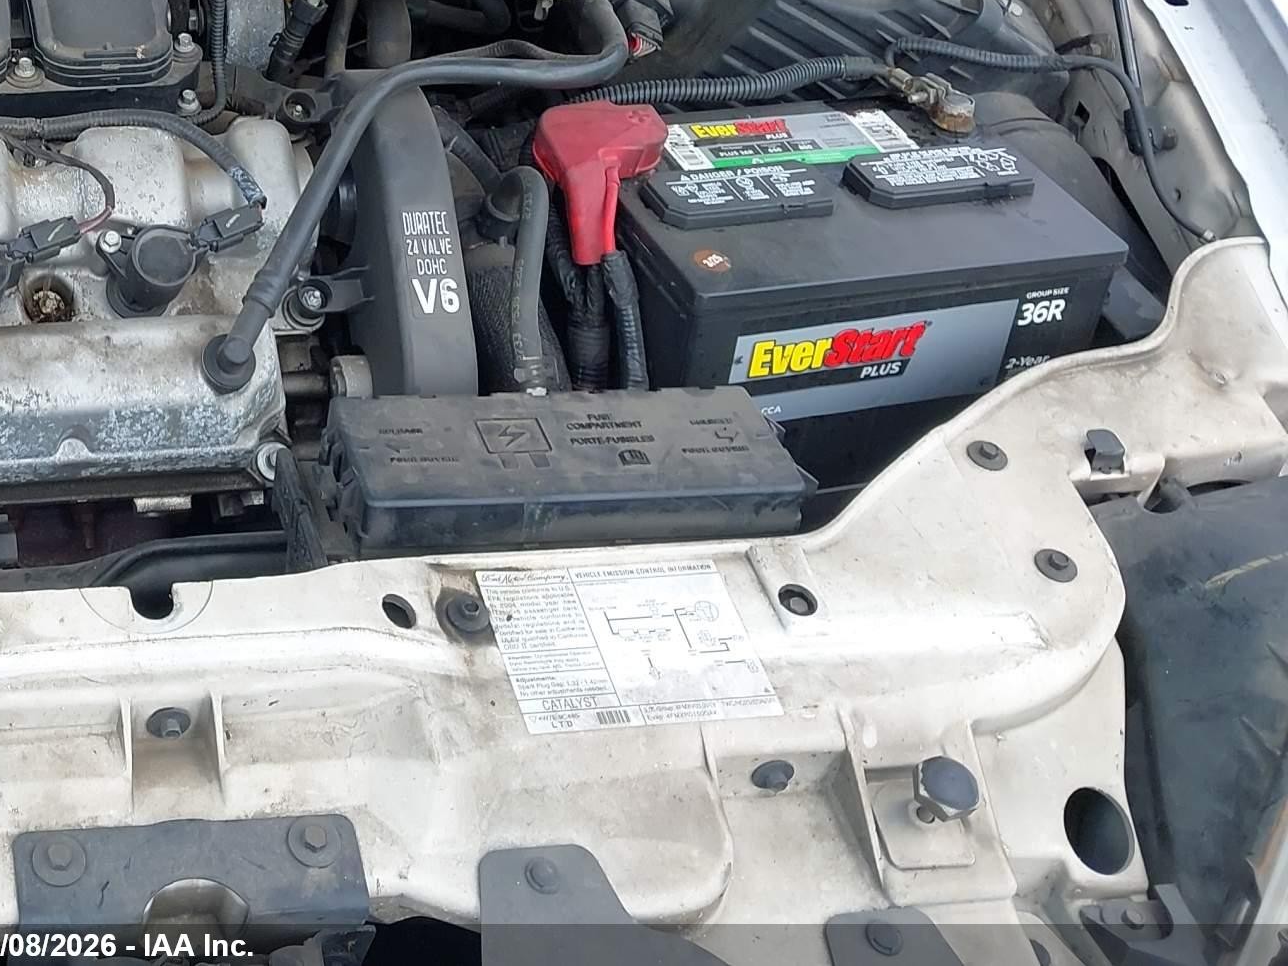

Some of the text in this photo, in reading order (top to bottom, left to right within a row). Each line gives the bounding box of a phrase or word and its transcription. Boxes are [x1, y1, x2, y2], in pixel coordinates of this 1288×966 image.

[689, 117, 787, 139] EverStart
[766, 132, 789, 140] PLUS
[690, 170, 735, 181] DANGER
[743, 165, 785, 175] POISON
[402, 211, 449, 235] DURATEC
[406, 238, 453, 255] 24 VALVE
[416, 258, 448, 275] DOHC
[411, 278, 460, 314] V6
[1026, 286, 1070, 299] GROUP SIZE
[1017, 299, 1067, 326] 36R
[747, 319, 927, 379] EverStart
[860, 361, 902, 378] PLUS
[1005, 354, 1050, 369] 2-Year
[566, 420, 643, 431] COMPARTMENT
[574, 563, 712, 579] VEHICLE EMISSION CONTROL INFORMATION
[542, 696, 599, 711] CATALYST
